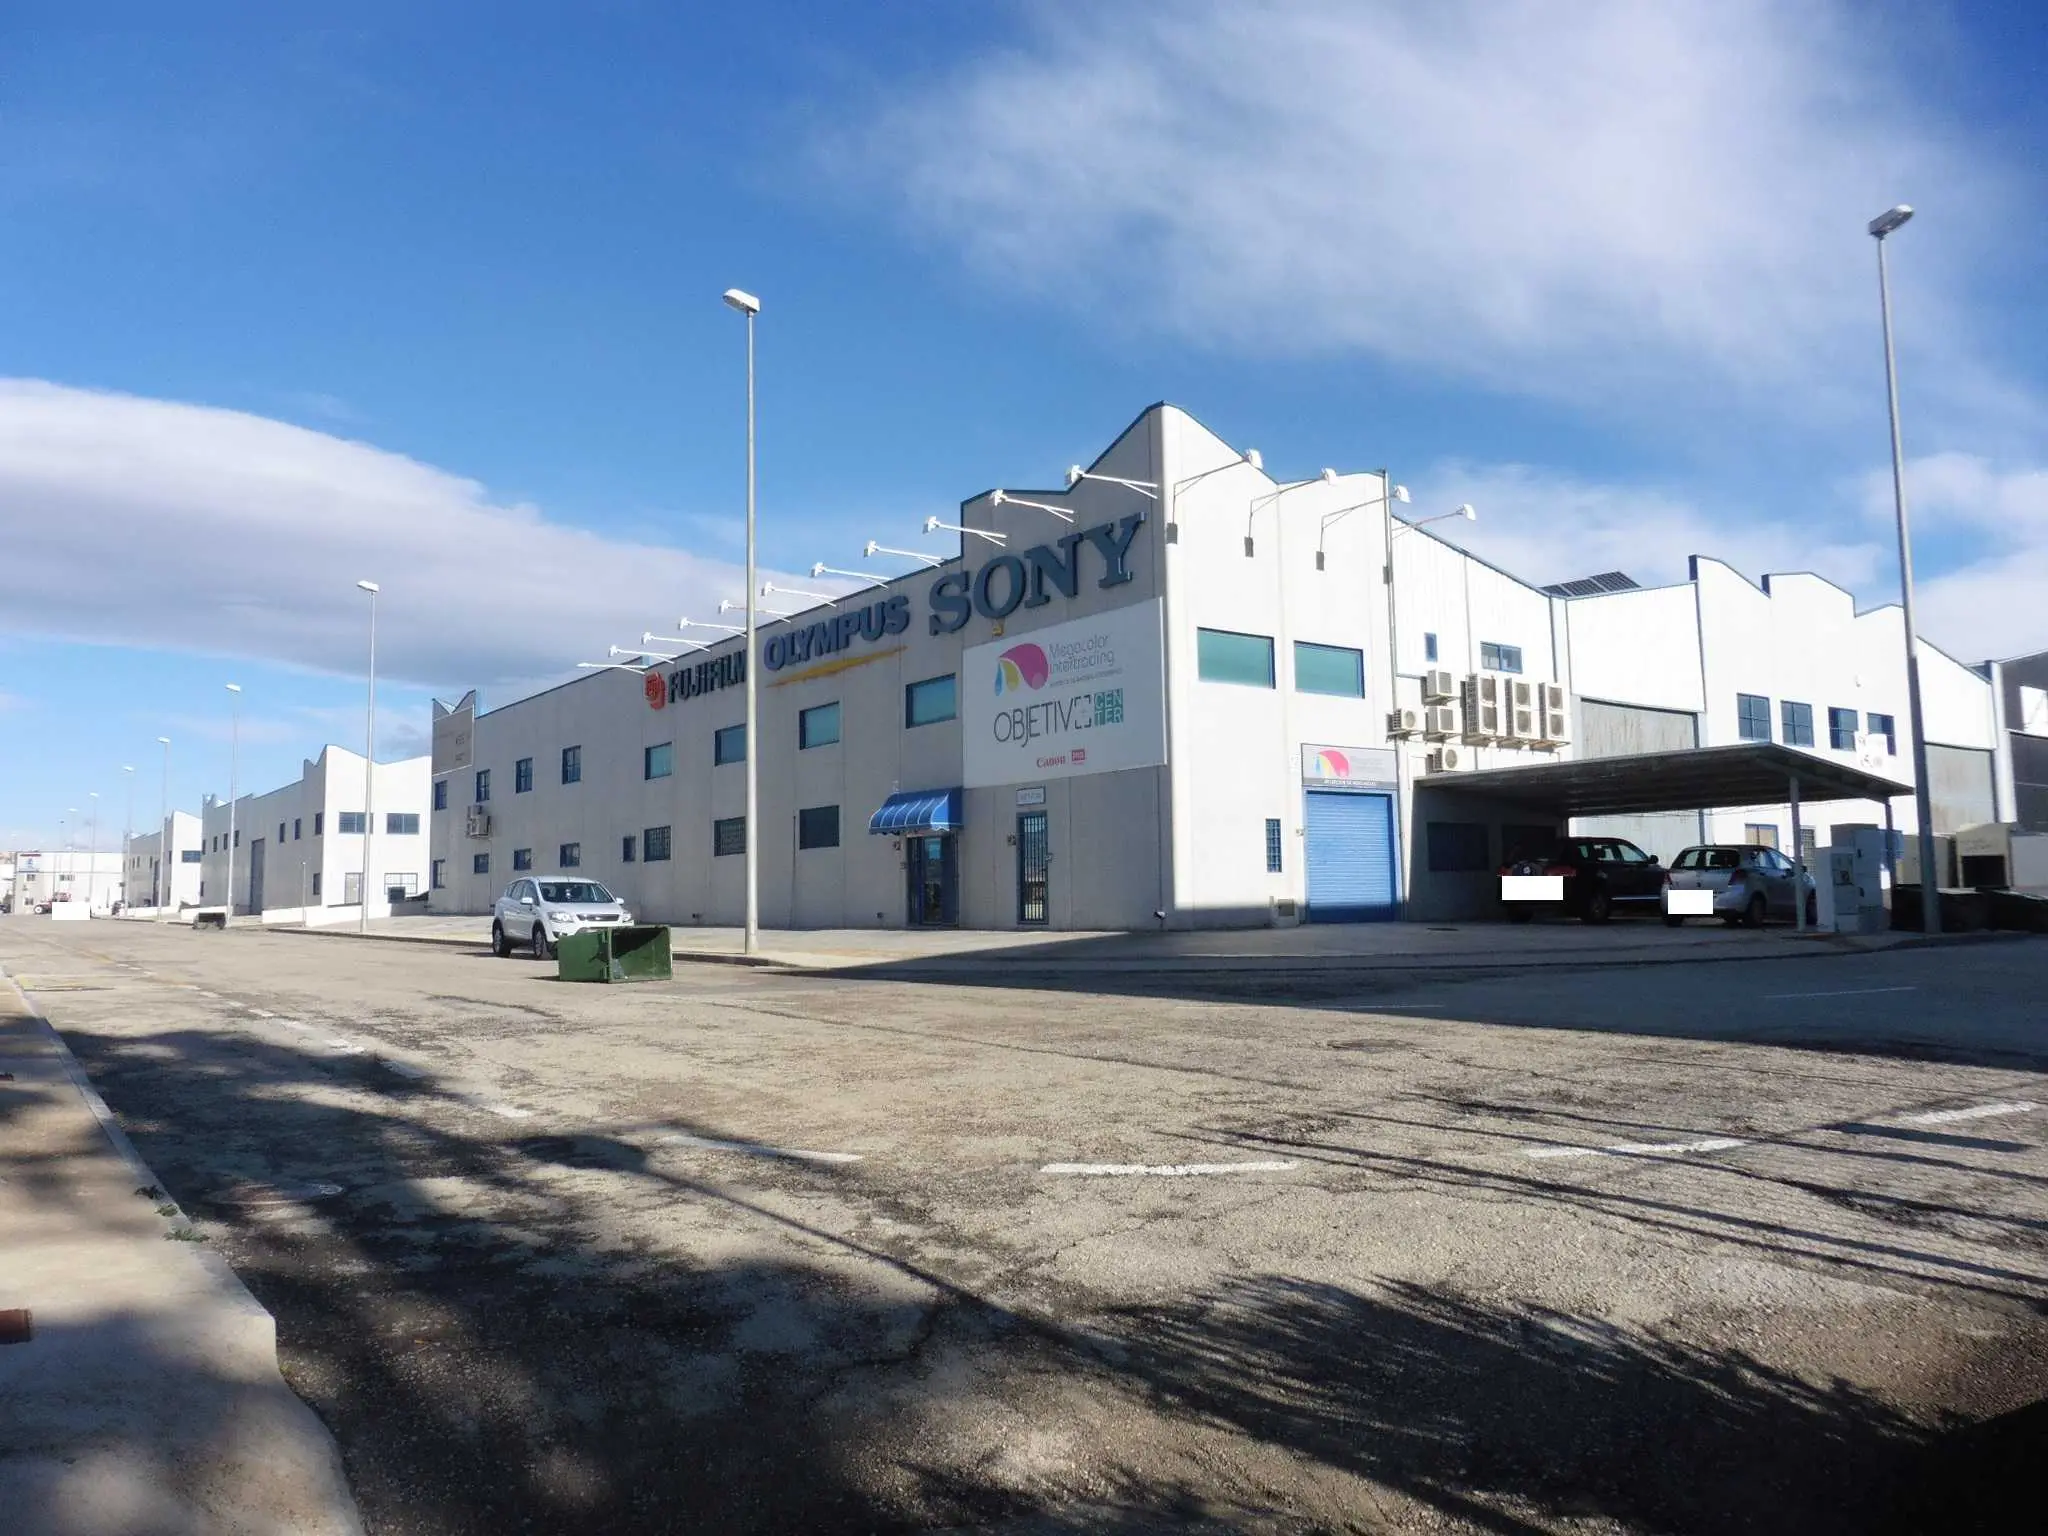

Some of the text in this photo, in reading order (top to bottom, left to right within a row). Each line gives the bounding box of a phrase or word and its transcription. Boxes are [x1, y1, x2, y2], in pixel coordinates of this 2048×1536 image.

[929, 512, 1146, 636] SONY
[763, 596, 910, 671] OLYMPUS
[668, 648, 747, 704] FUJIFILM
